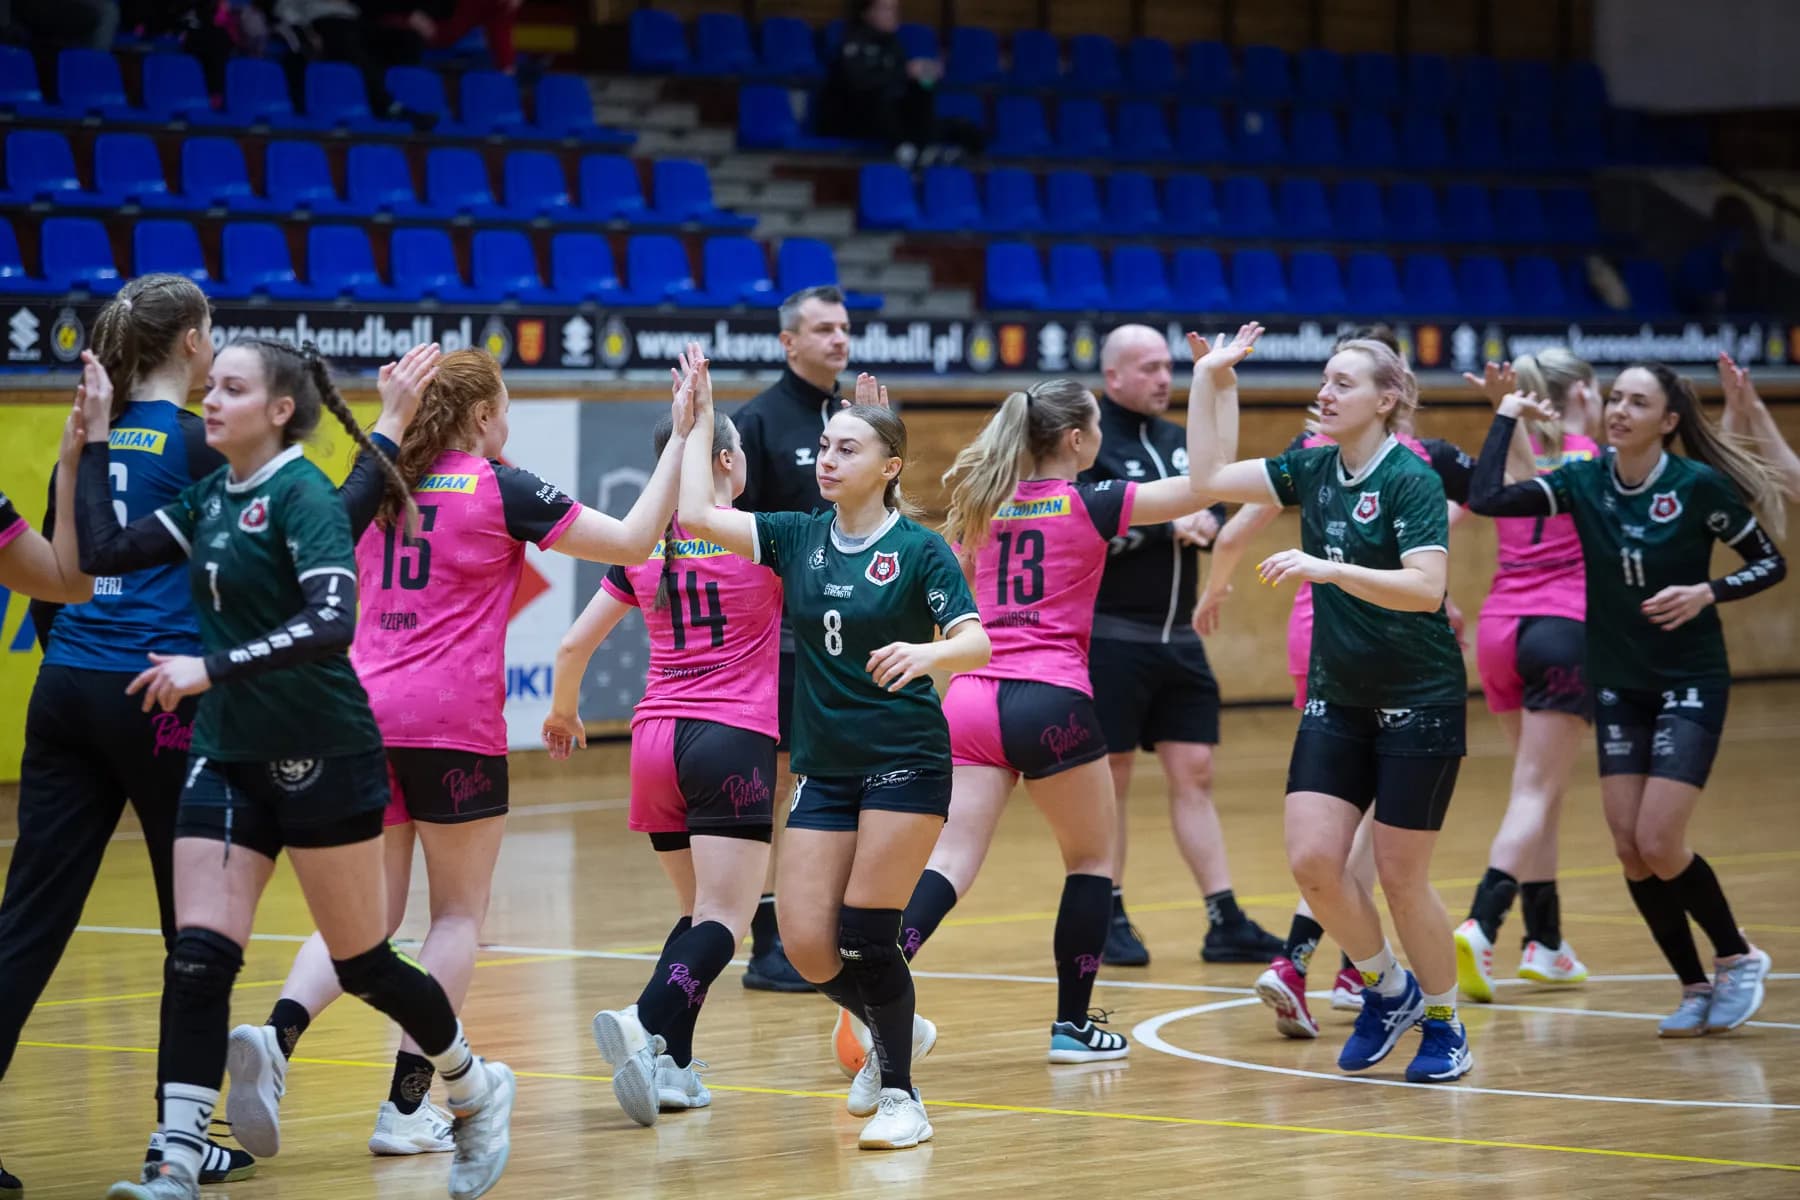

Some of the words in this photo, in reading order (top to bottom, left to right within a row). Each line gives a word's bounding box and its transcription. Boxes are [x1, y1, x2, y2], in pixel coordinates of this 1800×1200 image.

[382, 505, 438, 590] 15
[997, 530, 1044, 606] 13
[1620, 547, 1645, 587] 11
[381, 613, 417, 631] RZEPKA
[669, 571, 727, 650] 14
[823, 609, 843, 657] 8
